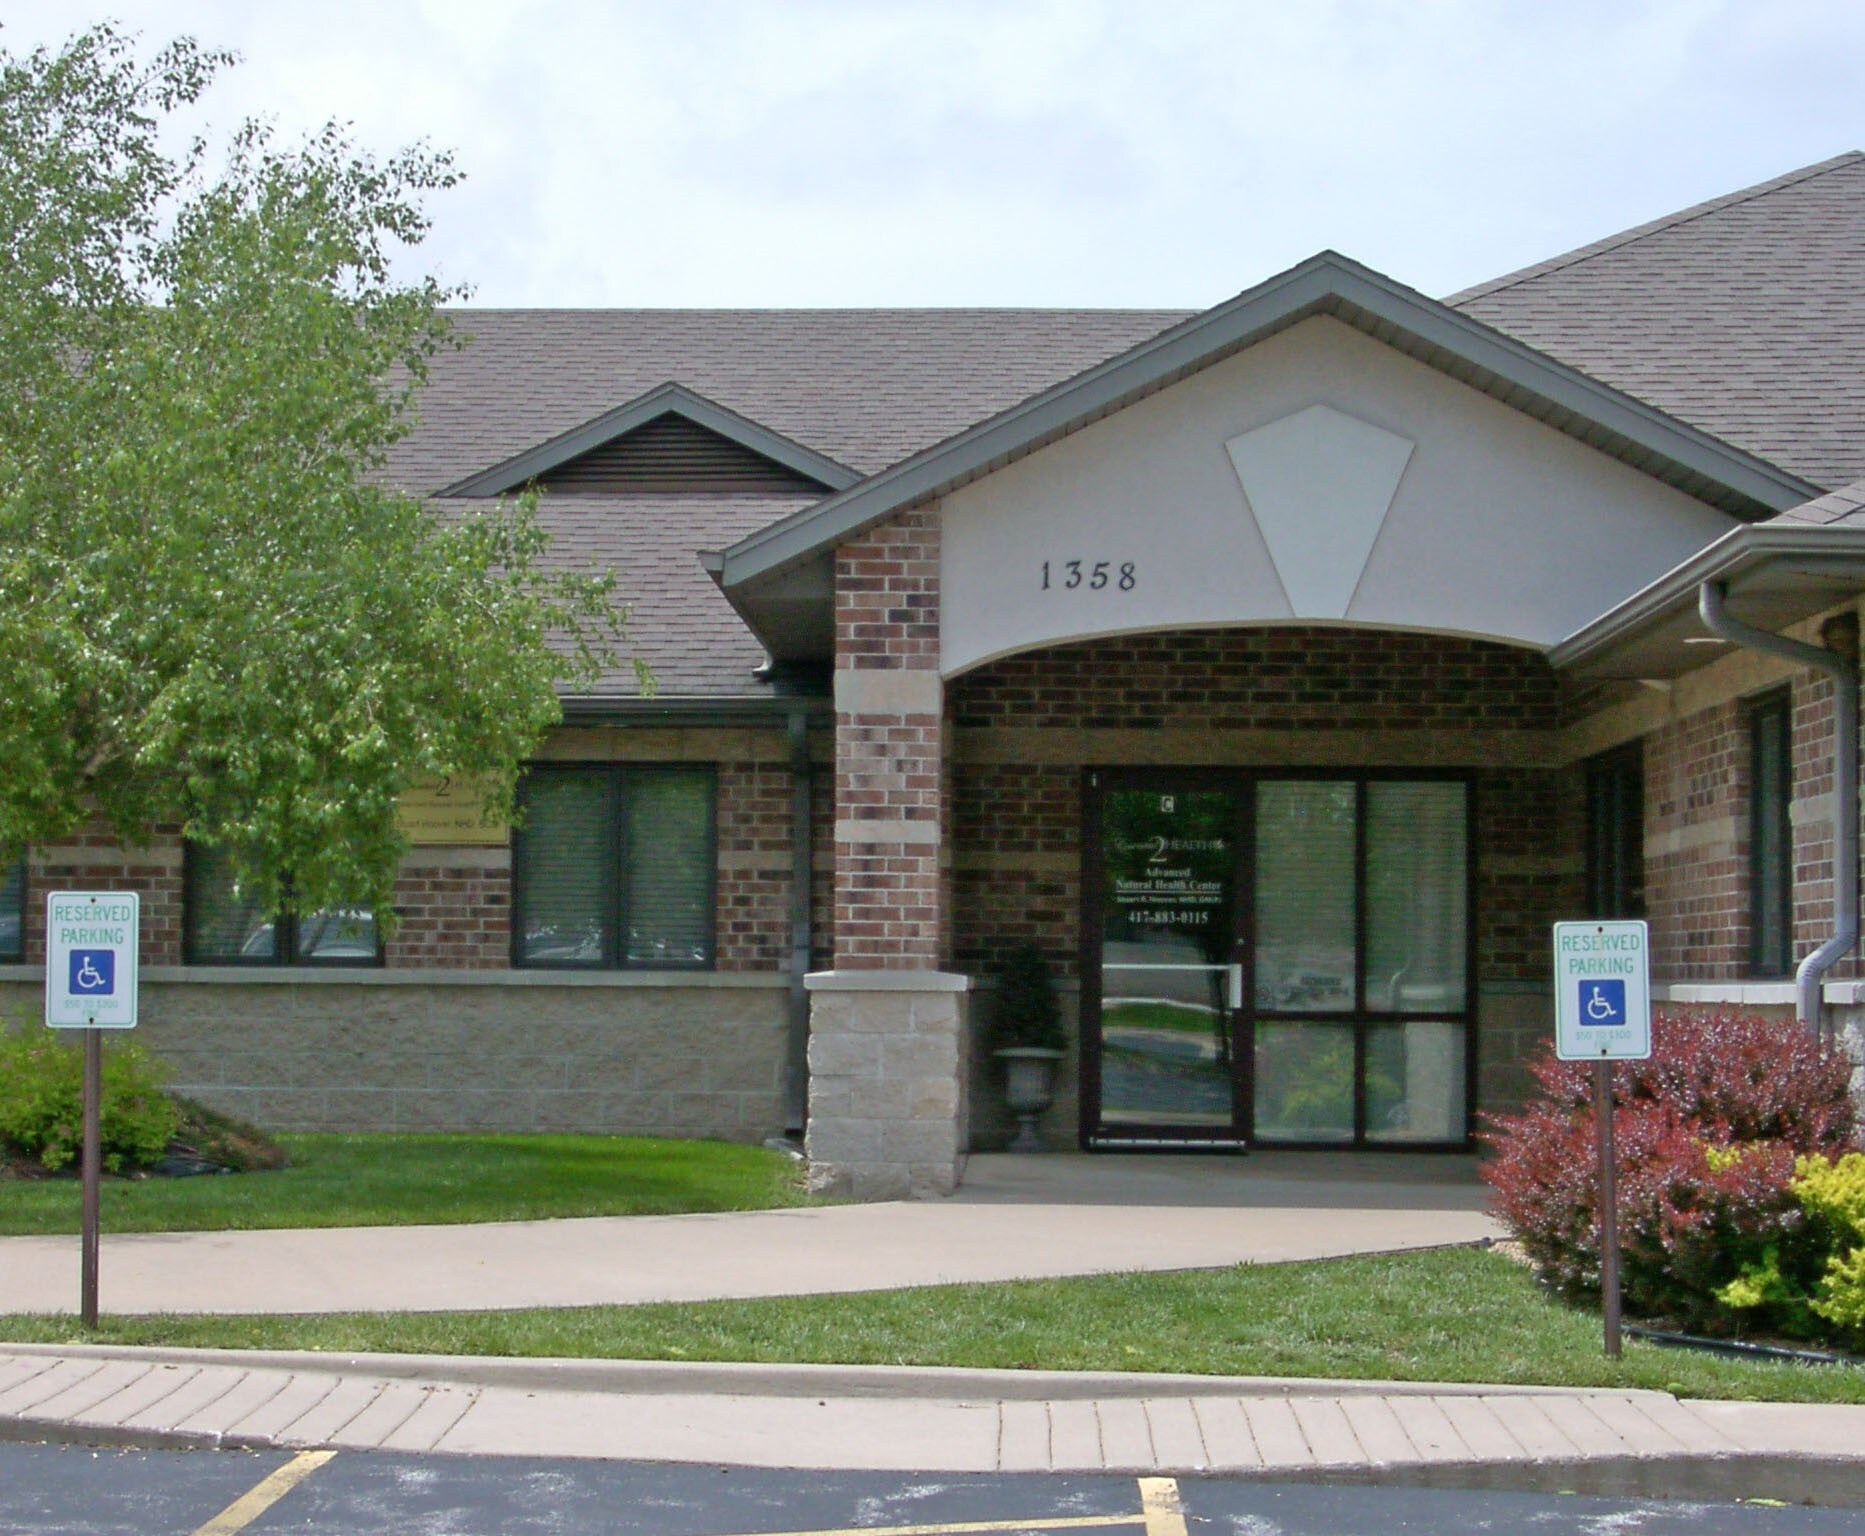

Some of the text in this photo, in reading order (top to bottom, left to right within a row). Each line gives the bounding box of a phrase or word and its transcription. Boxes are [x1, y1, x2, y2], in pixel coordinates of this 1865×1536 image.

[1041, 560, 1135, 590] 1358
[1149, 835, 1167, 862] 2
[1145, 867, 1191, 878] Advanced
[1115, 879, 1222, 890] Natural Health Center
[55, 905, 131, 921] RESERVED
[61, 928, 124, 944] PARKING
[1562, 934, 1640, 951] RESERVED
[1569, 957, 1634, 974] PARKING
